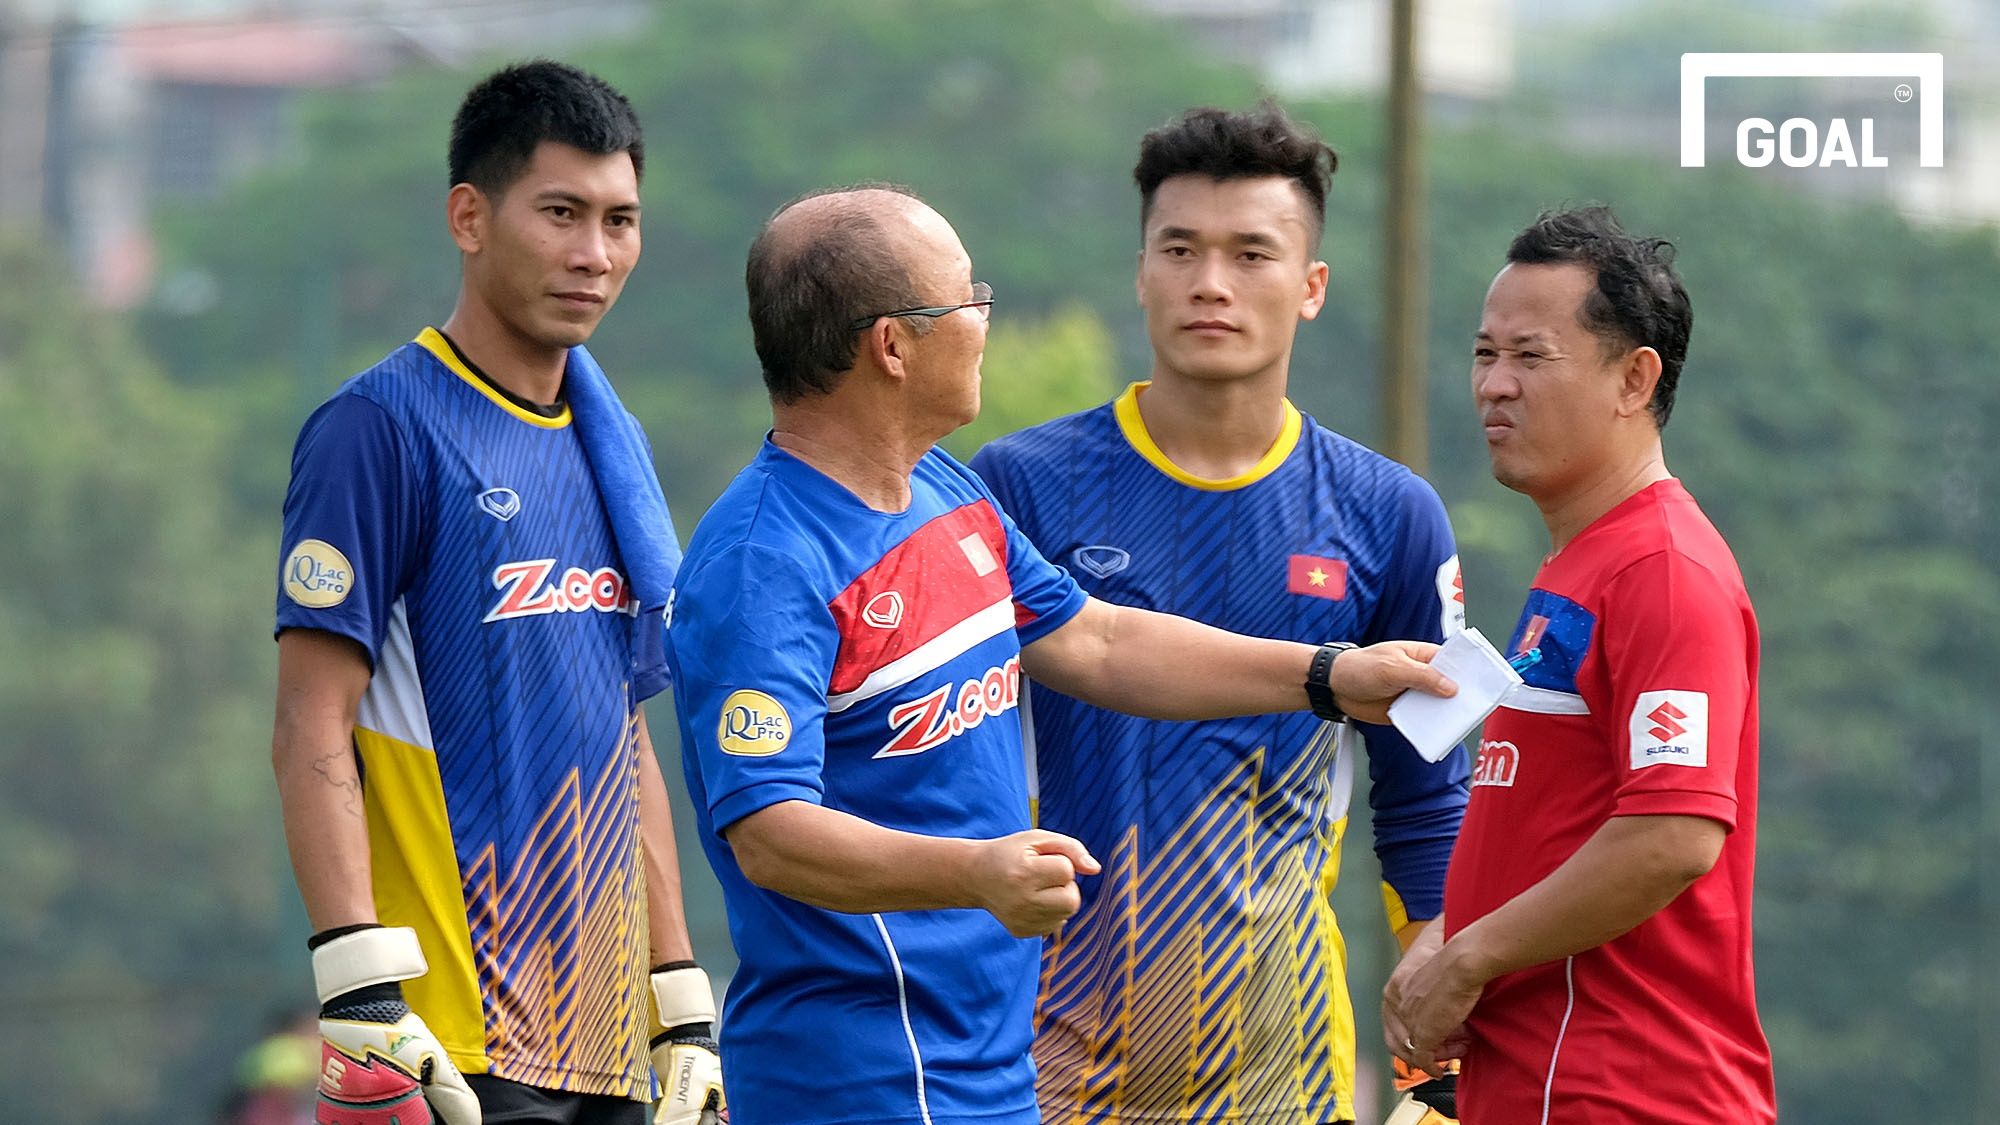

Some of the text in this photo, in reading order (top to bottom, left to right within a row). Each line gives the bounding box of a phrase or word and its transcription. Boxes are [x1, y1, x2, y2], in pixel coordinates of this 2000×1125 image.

[290, 556, 345, 591] IQ Lac
[317, 579, 344, 593] Pro
[483, 558, 640, 624] Z.co
[724, 706, 783, 741] IQ Lac
[758, 727, 785, 740] Pro
[1646, 745, 1689, 756] SUZUKI
